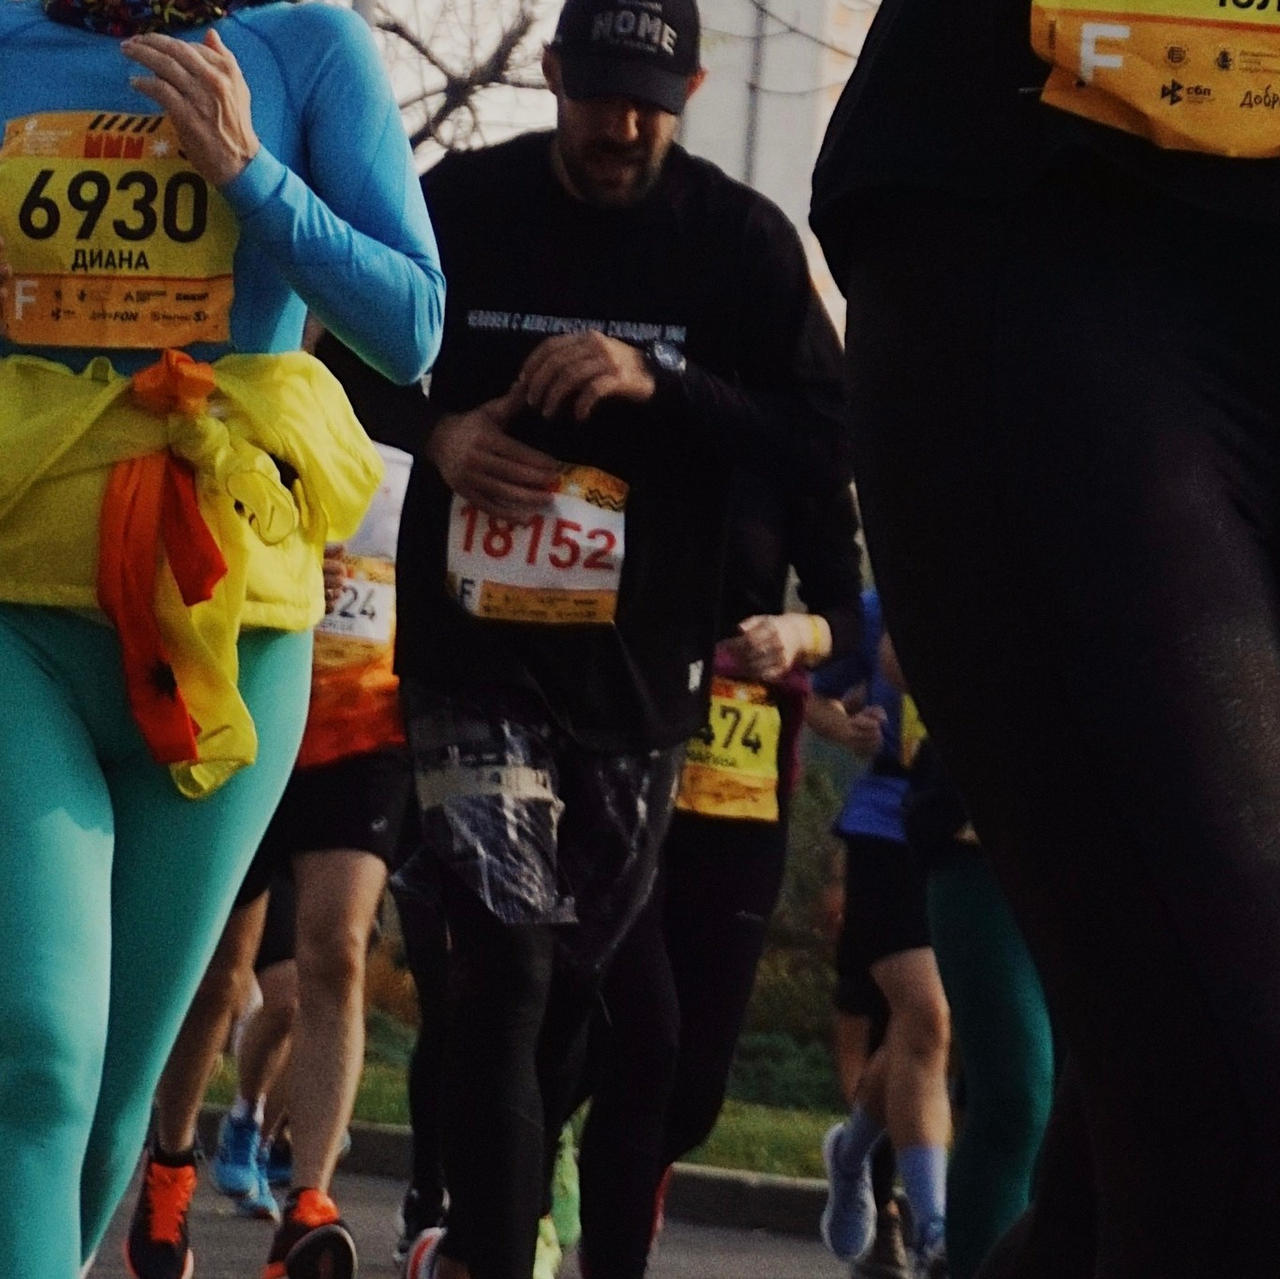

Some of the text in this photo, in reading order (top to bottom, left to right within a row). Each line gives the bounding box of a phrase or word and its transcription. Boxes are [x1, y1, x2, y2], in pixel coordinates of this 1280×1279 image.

[1080, 23, 1131, 84] F
[18, 168, 208, 243] 6930
[71, 249, 149, 272] ДИАНА
[15, 279, 39, 321] F
[460, 504, 617, 571] 18152
